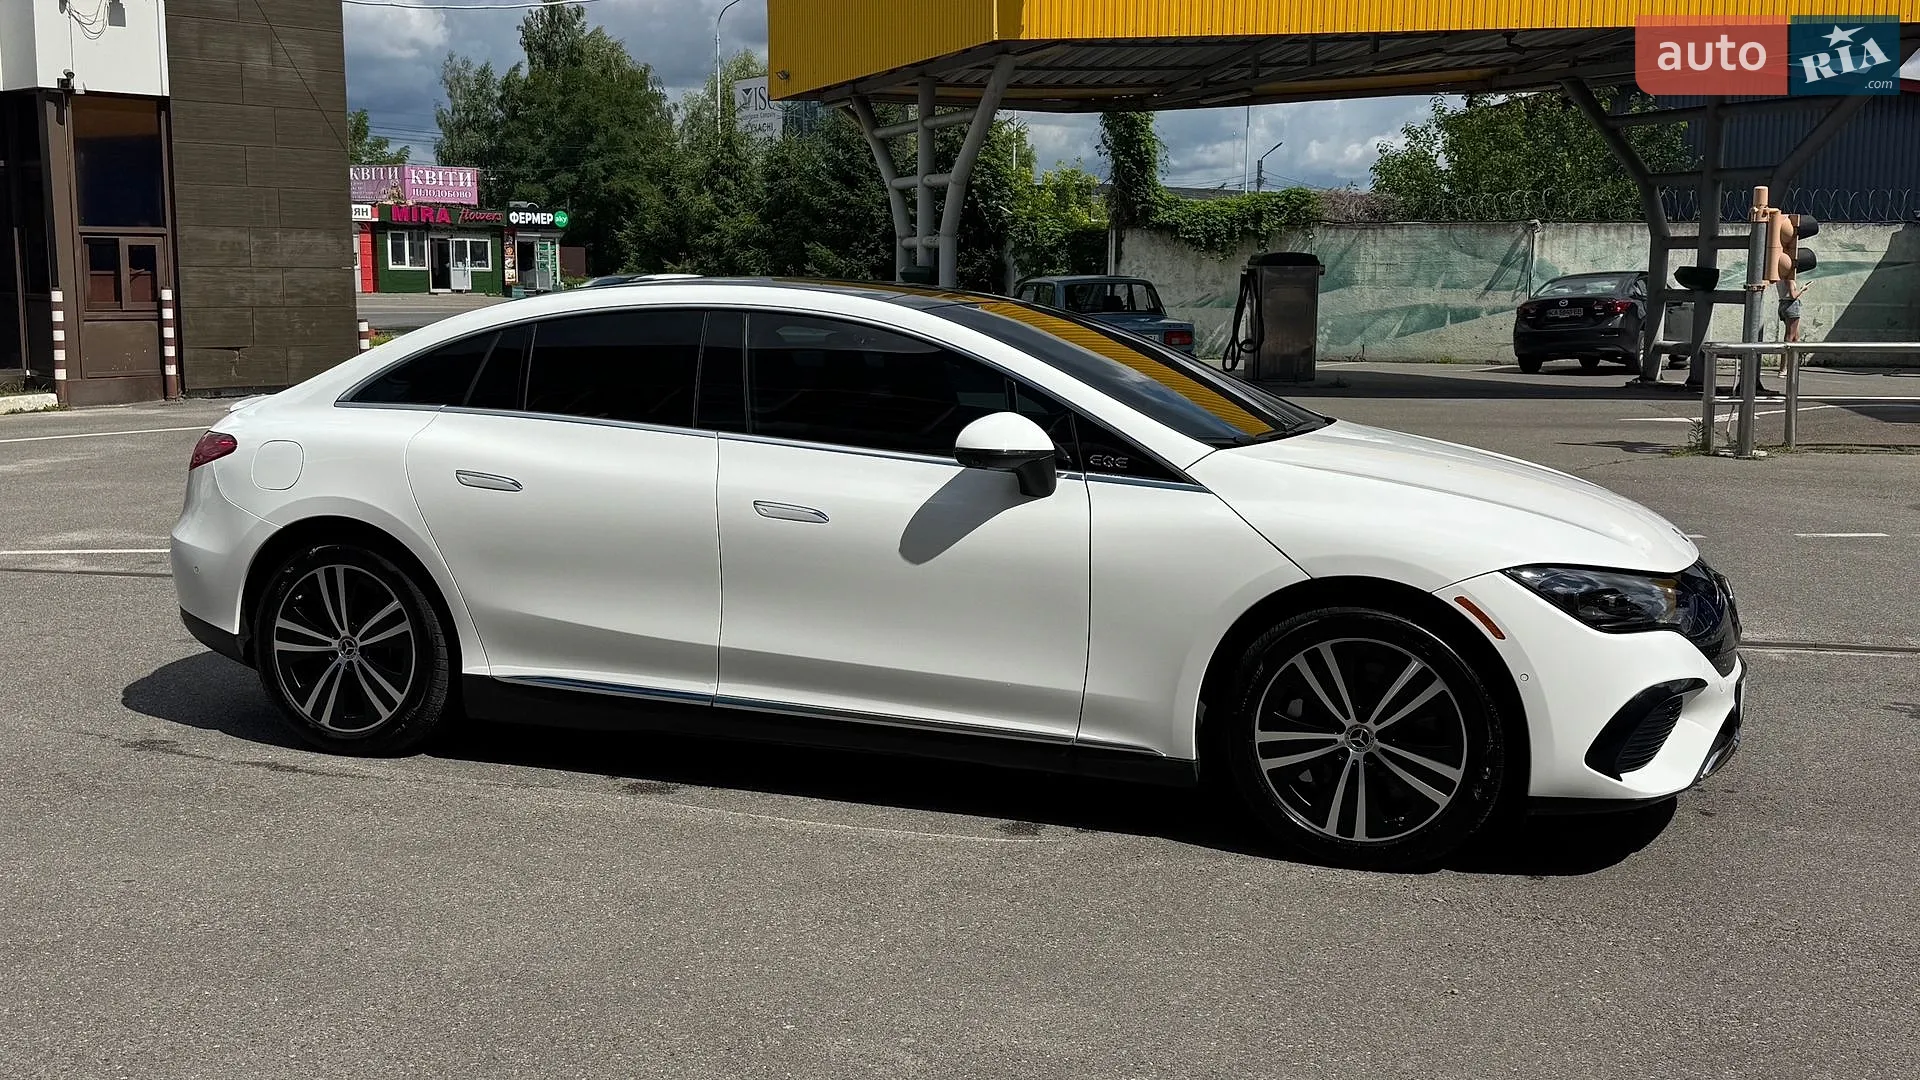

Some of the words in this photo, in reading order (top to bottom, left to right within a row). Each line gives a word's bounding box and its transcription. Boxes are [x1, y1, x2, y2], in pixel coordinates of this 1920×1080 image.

[350, 166, 399, 181] КВІТИ
[409, 168, 473, 188] КВІТИ
[412, 187, 472, 199] ЦІЛОДОБОВО
[351, 206, 369, 217] ЯН
[391, 204, 453, 225] MIRA
[509, 210, 554, 225] ФЕРМЕР
[1089, 454, 1129, 469] EQE
